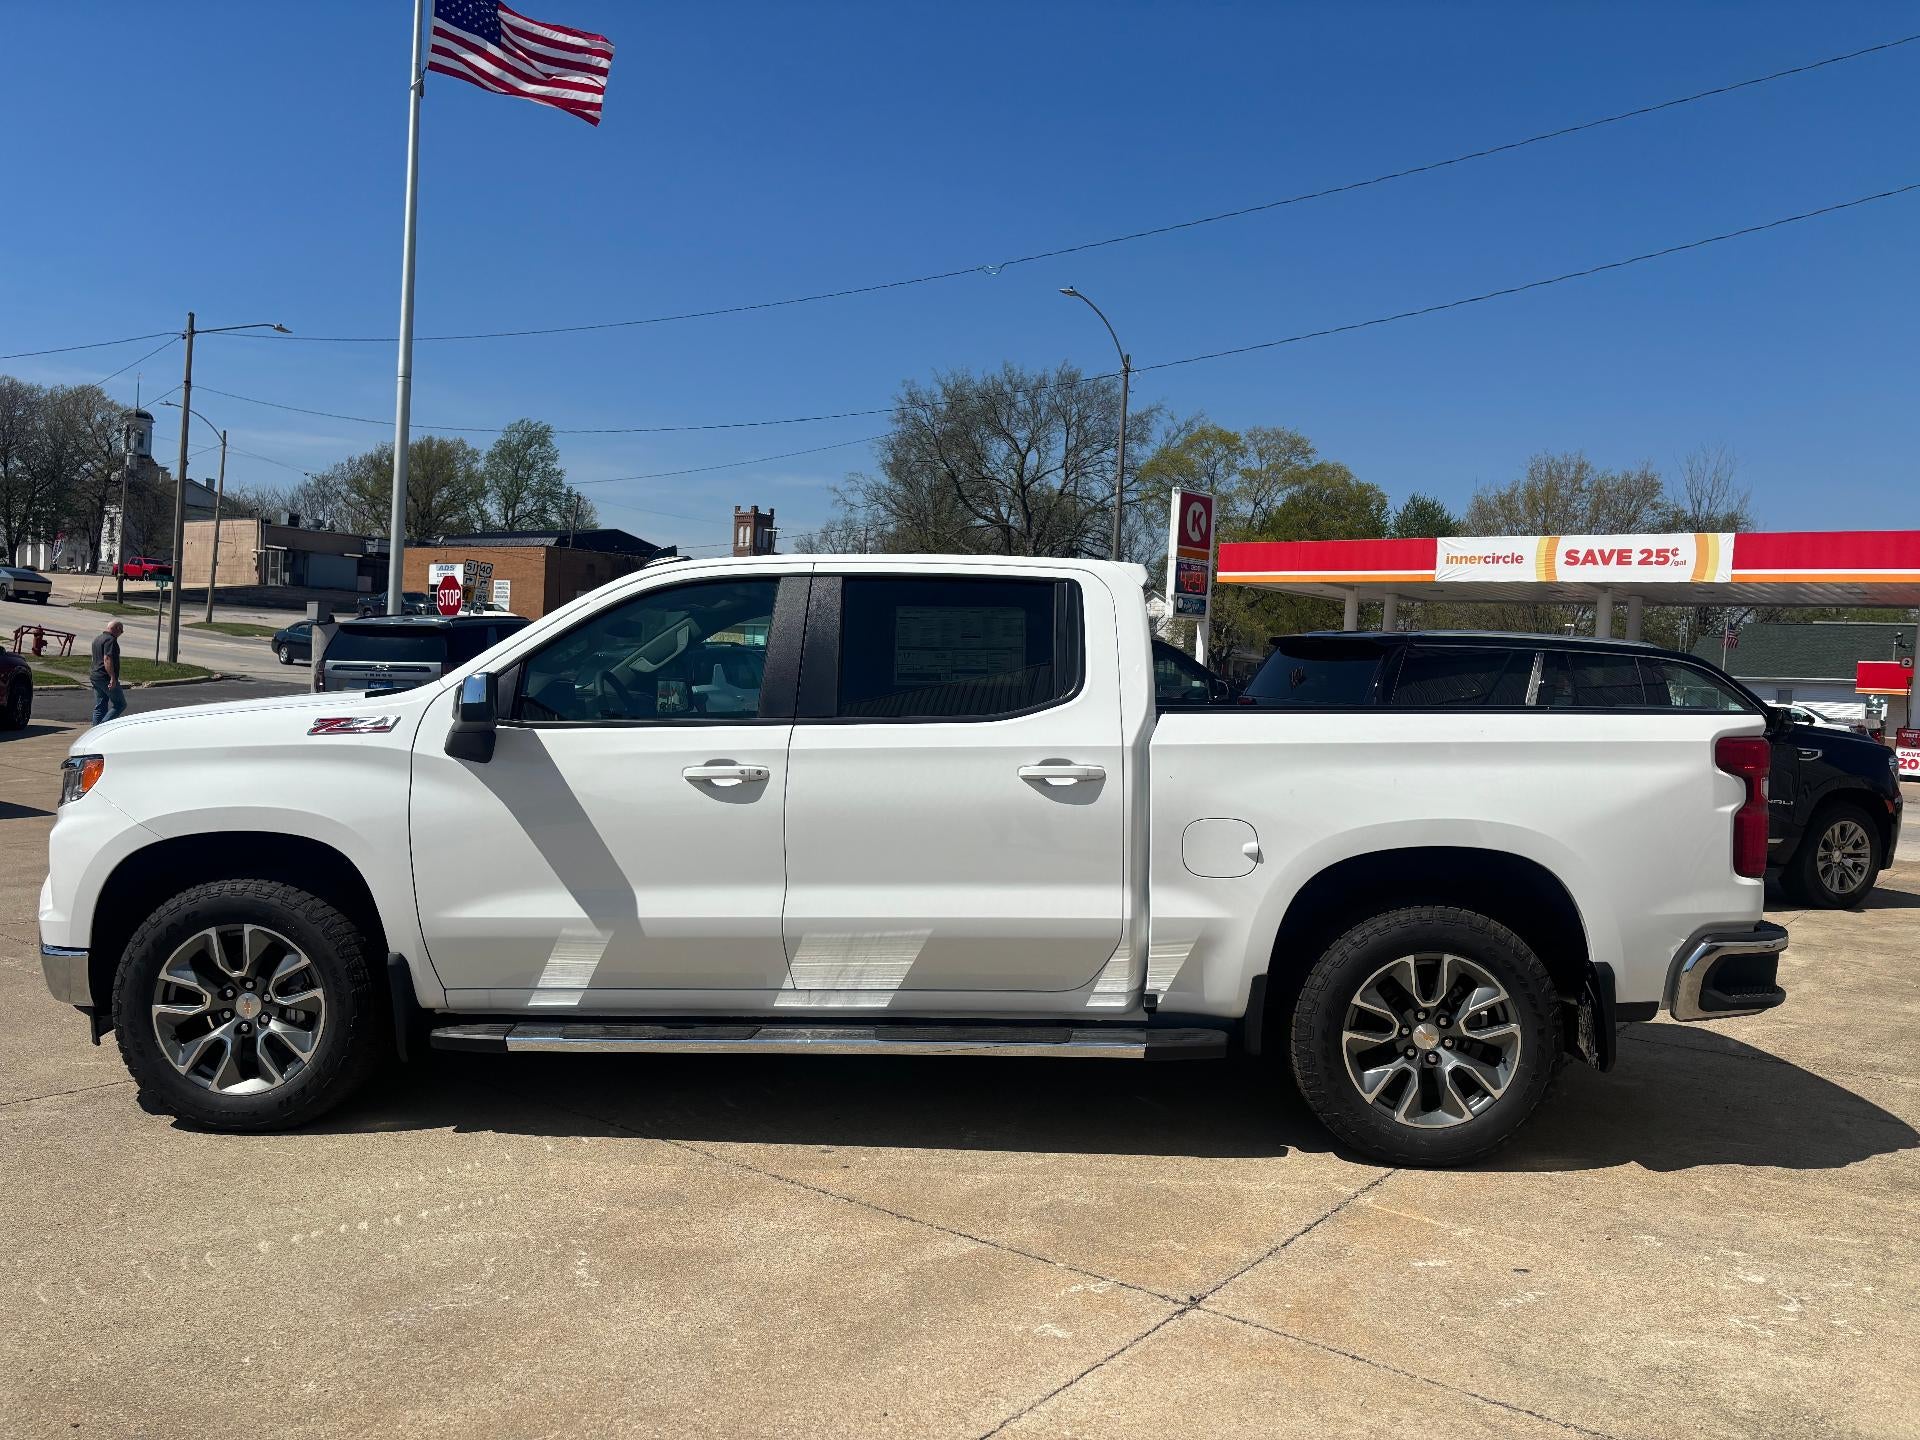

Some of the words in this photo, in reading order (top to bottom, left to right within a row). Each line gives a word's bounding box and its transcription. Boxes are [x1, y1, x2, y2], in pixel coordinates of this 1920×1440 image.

[1446, 552, 1524, 564] innercircle
[1564, 548, 1632, 566] SAVE
[467, 562, 476, 574] 51
[480, 565, 492, 575] 40
[439, 589, 460, 606] STOP
[307, 716, 401, 735] Z71
